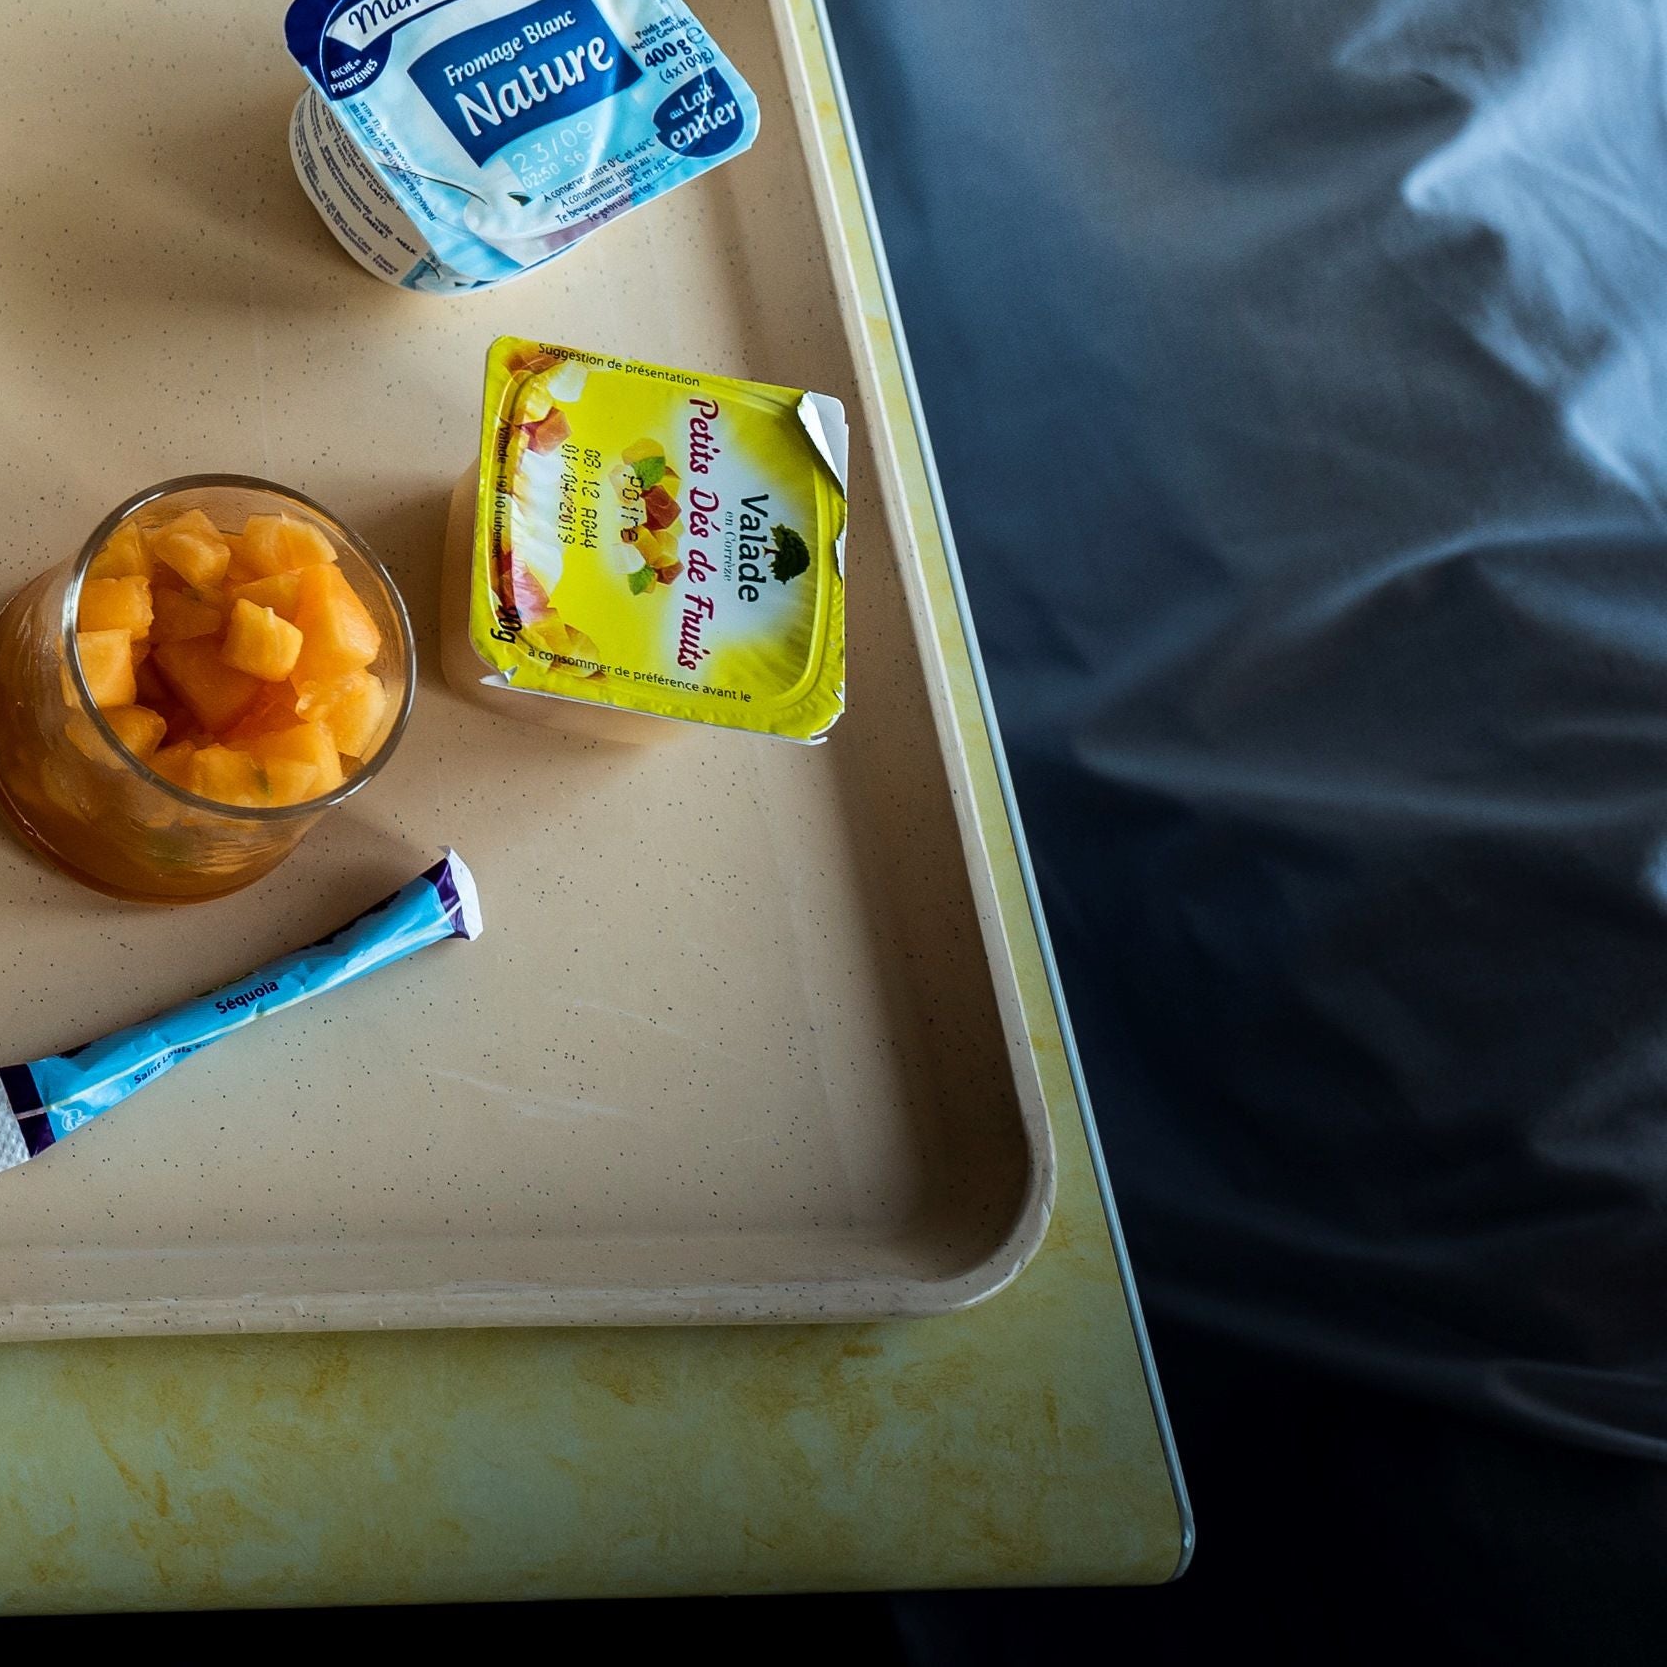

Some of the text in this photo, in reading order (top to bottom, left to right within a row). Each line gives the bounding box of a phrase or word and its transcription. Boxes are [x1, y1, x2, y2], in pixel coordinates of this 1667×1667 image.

[330, 60, 356, 79] RICHE
[443, 10, 576, 87] Fromage Blanc
[645, 42, 678, 68] 400
[330, 58, 378, 94] PROTÉINES
[455, 36, 614, 137] Nature
[680, 83, 715, 112] Lait
[512, 121, 594, 173] 23/09
[538, 343, 700, 387] Suggestion de présentation
[558, 443, 580, 545] 01/04/2019
[620, 473, 644, 542] Poire
[678, 397, 721, 671] Petits Dés de Fruits
[723, 511, 736, 582] en Corrèze
[738, 493, 769, 603] Valade
[538, 650, 612, 673] consommer
[614, 665, 630, 678] de
[633, 671, 699, 692] préférence
[702, 684, 737, 701] avant
[740, 690, 751, 703] le
[215, 980, 279, 1014] Séquoia
